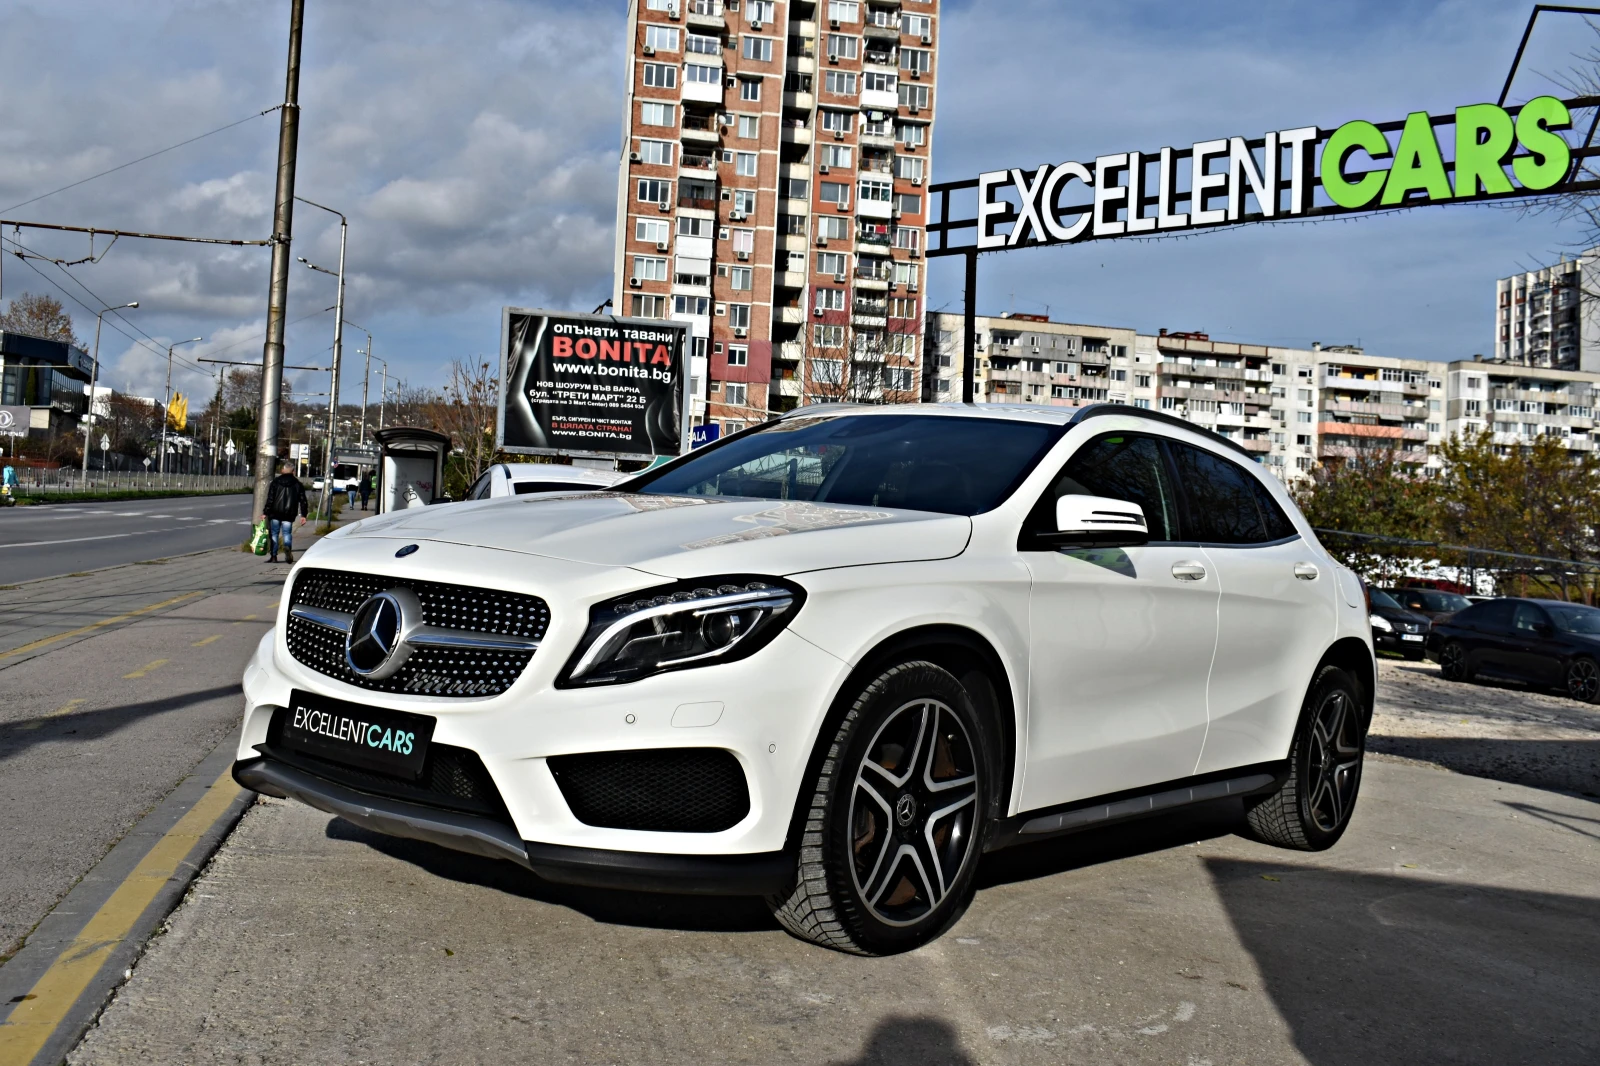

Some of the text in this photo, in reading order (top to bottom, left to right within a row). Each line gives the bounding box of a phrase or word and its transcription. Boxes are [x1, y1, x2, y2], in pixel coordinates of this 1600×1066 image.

[553, 324, 673, 343] опънати тавани
[552, 335, 671, 366] BONITA
[553, 363, 671, 383] www.bonita.bg
[555, 382, 591, 390] ШОУРУМ
[593, 384, 611, 392] ВЪВ
[613, 385, 640, 394] ВАРНА
[529, 389, 550, 399] бул.
[626, 395, 637, 403] 22
[639, 396, 647, 404] Б
[552, 429, 632, 440] www.BONITA.bg
[560, 422, 594, 430] ЦЯЛАТА
[596, 424, 632, 432] СТРАНА!
